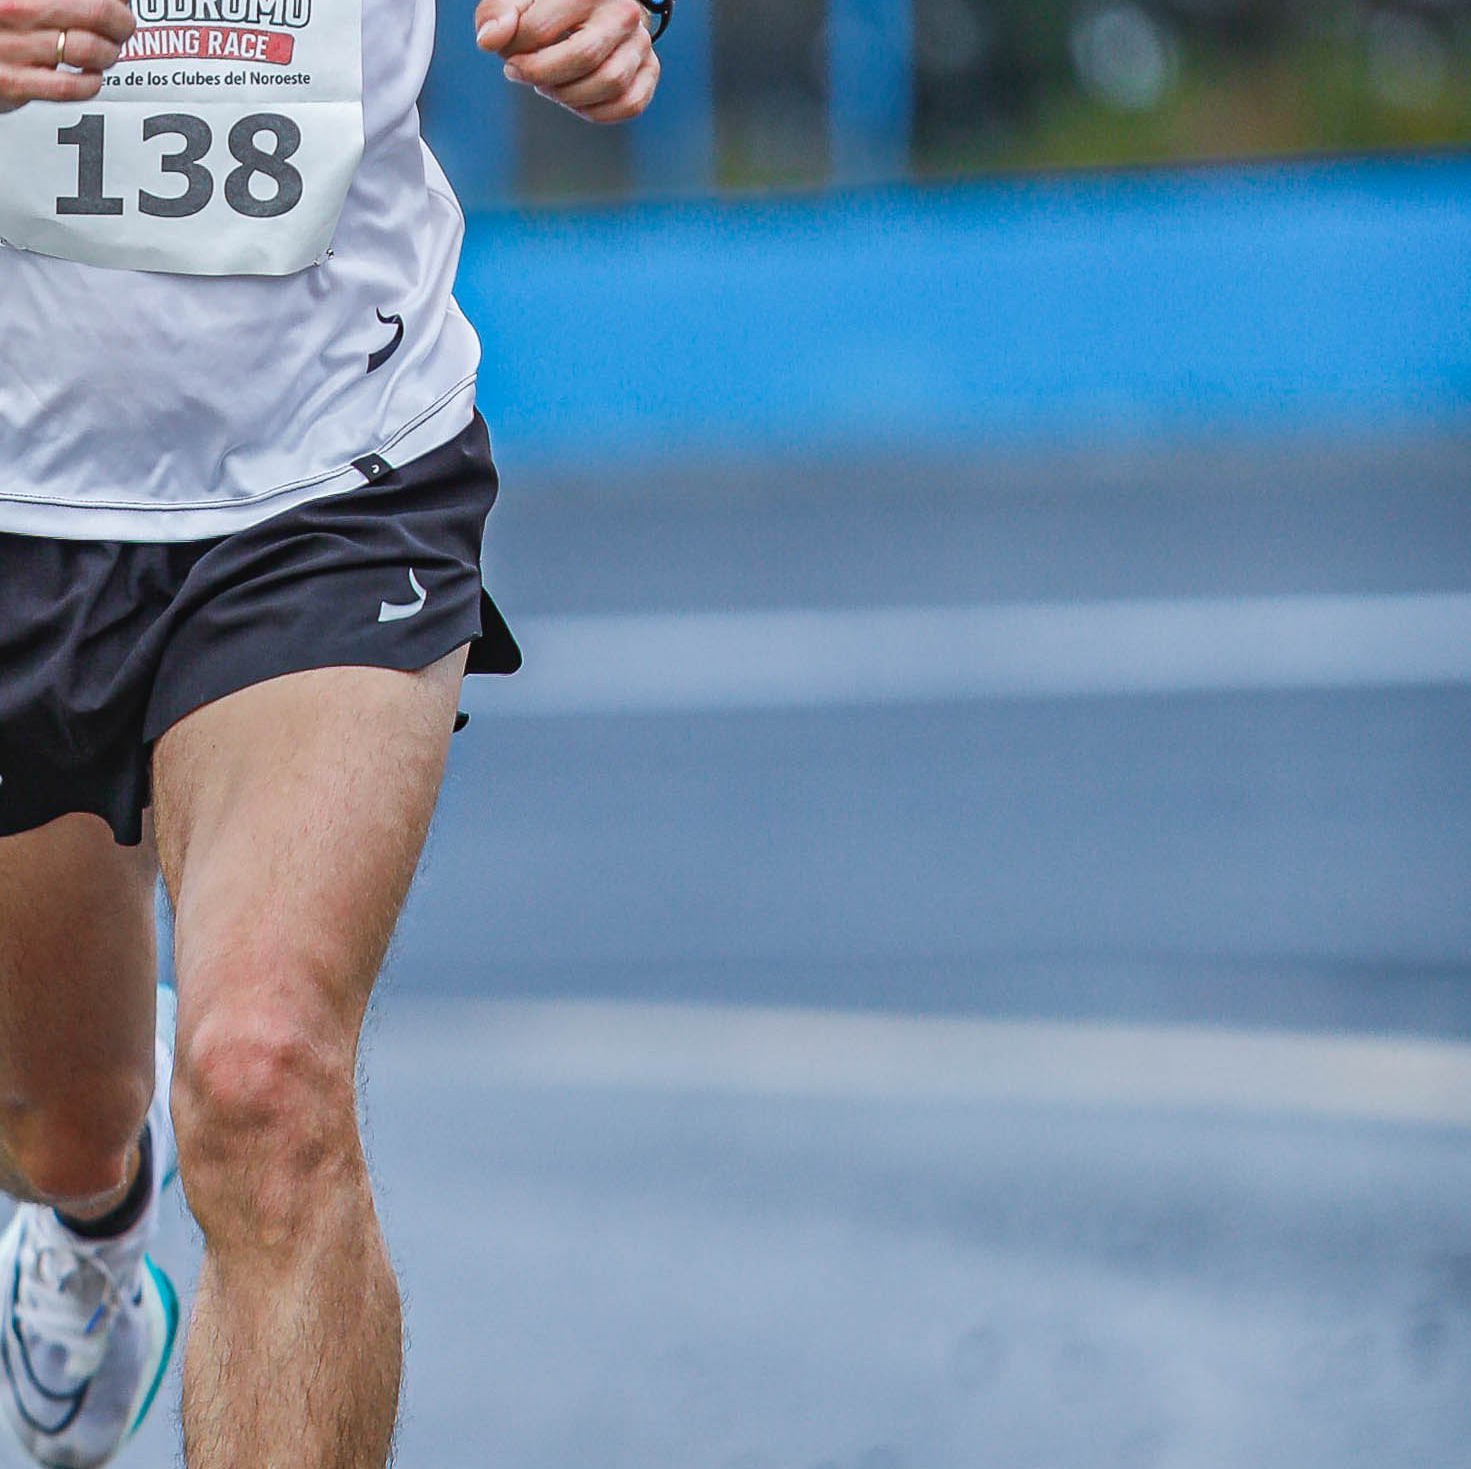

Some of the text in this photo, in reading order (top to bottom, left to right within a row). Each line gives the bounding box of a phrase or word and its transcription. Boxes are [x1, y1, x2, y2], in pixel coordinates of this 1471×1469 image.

[119, 28, 270, 61] NNING RACE
[124, 71, 144, 86] de
[147, 71, 169, 86] los
[171, 71, 221, 86] Clubes
[224, 71, 246, 86] del
[250, 71, 312, 86] Noroeste
[54, 112, 304, 219] 138
